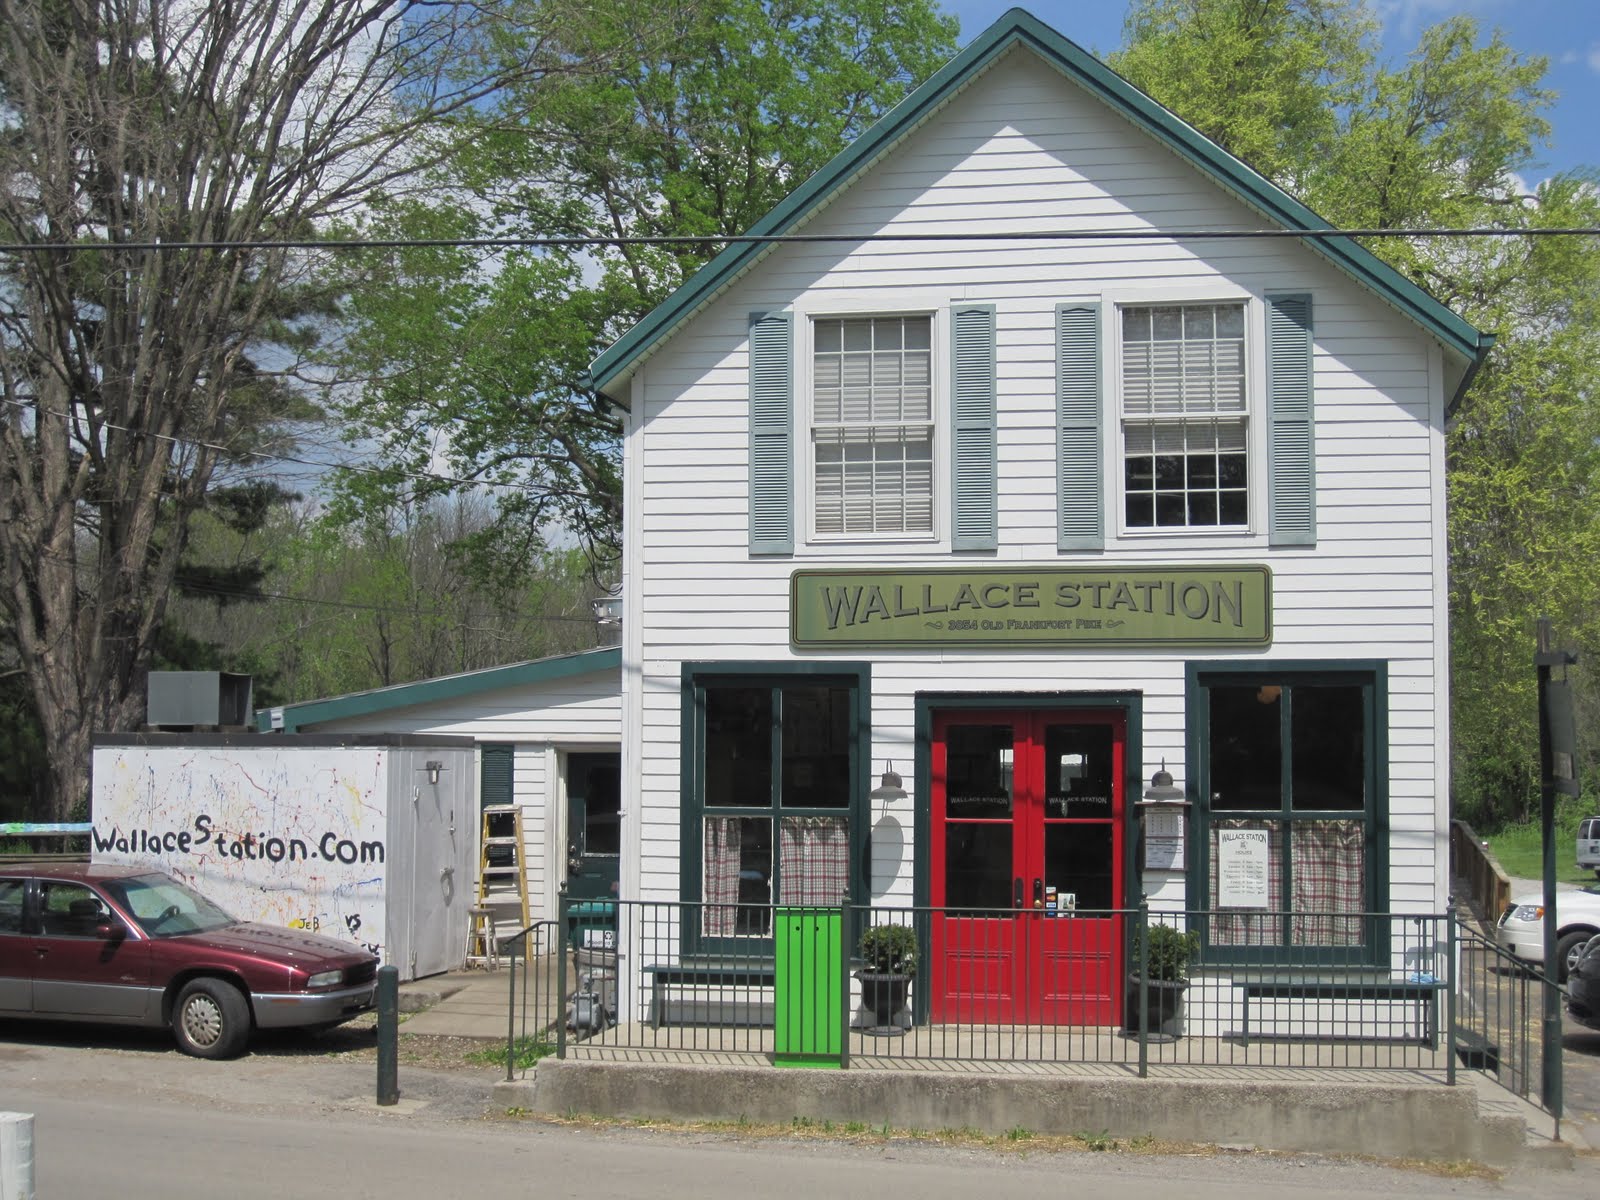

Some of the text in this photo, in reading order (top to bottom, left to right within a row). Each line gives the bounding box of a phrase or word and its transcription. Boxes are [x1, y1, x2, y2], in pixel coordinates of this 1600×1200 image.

[821, 580, 1244, 629] WALLACE STATION
[981, 619, 1005, 630] OLD
[1007, 618, 1074, 630] FRANKFORT
[1076, 618, 1103, 630] PIKE
[91, 814, 385, 864] WallaceStation.Com
[1222, 833, 1267, 844] WALLACE STATION
